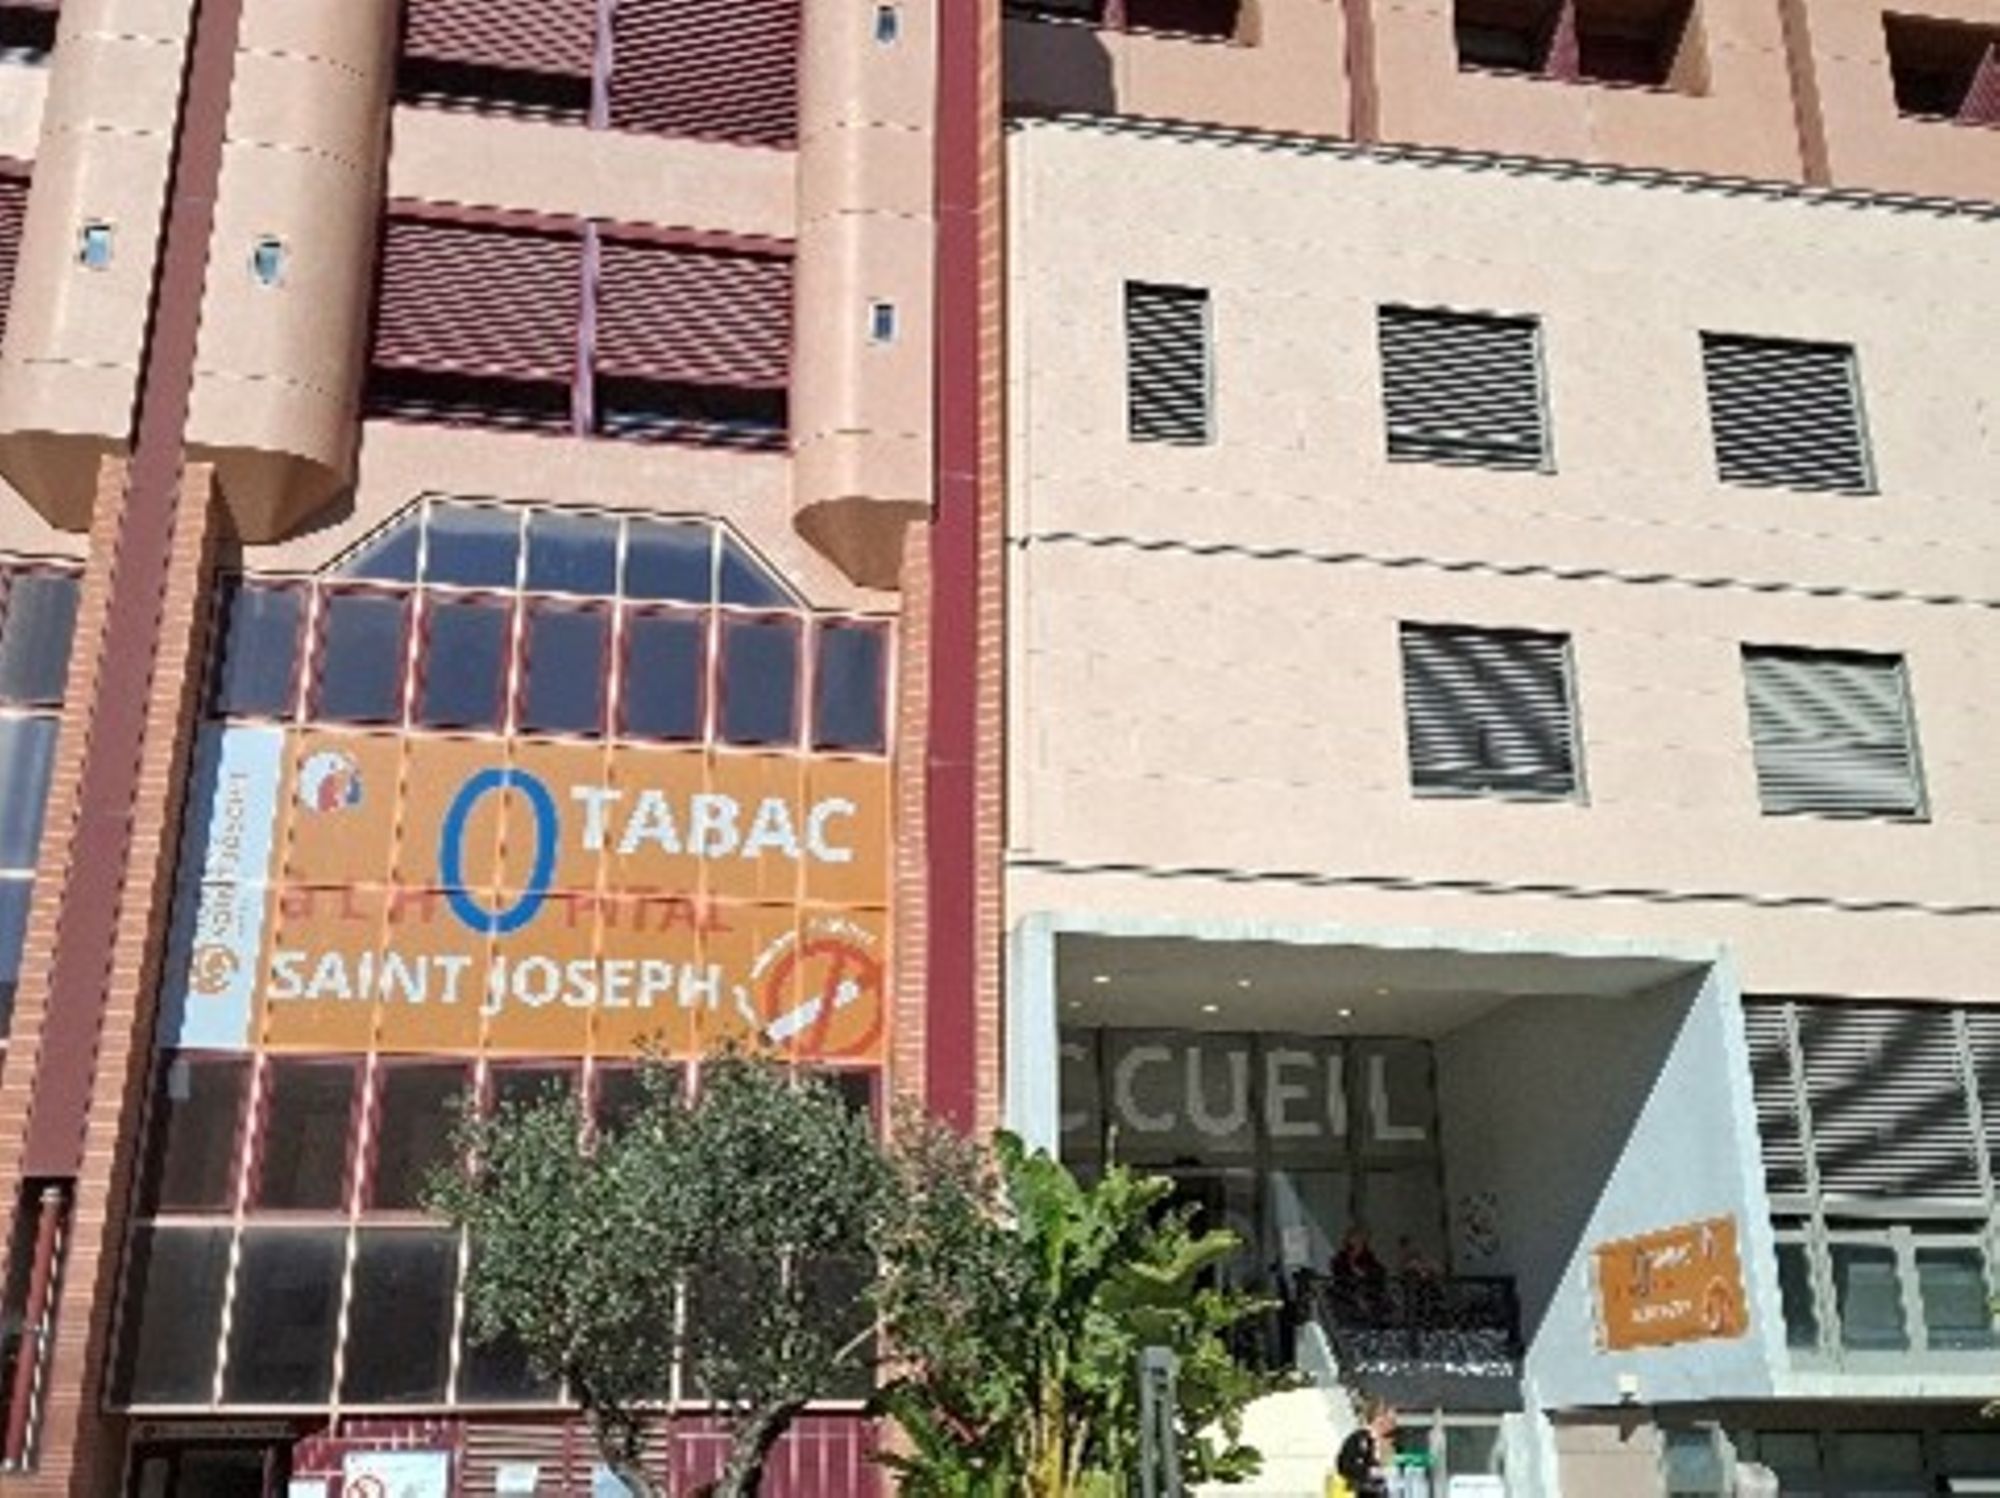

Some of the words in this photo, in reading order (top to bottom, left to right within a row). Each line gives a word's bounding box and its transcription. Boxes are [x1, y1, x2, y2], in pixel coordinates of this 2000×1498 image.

[570, 785, 857, 862] TABAC
[266, 949, 472, 1003] SAINT
[478, 955, 723, 1016] JOSEPH
